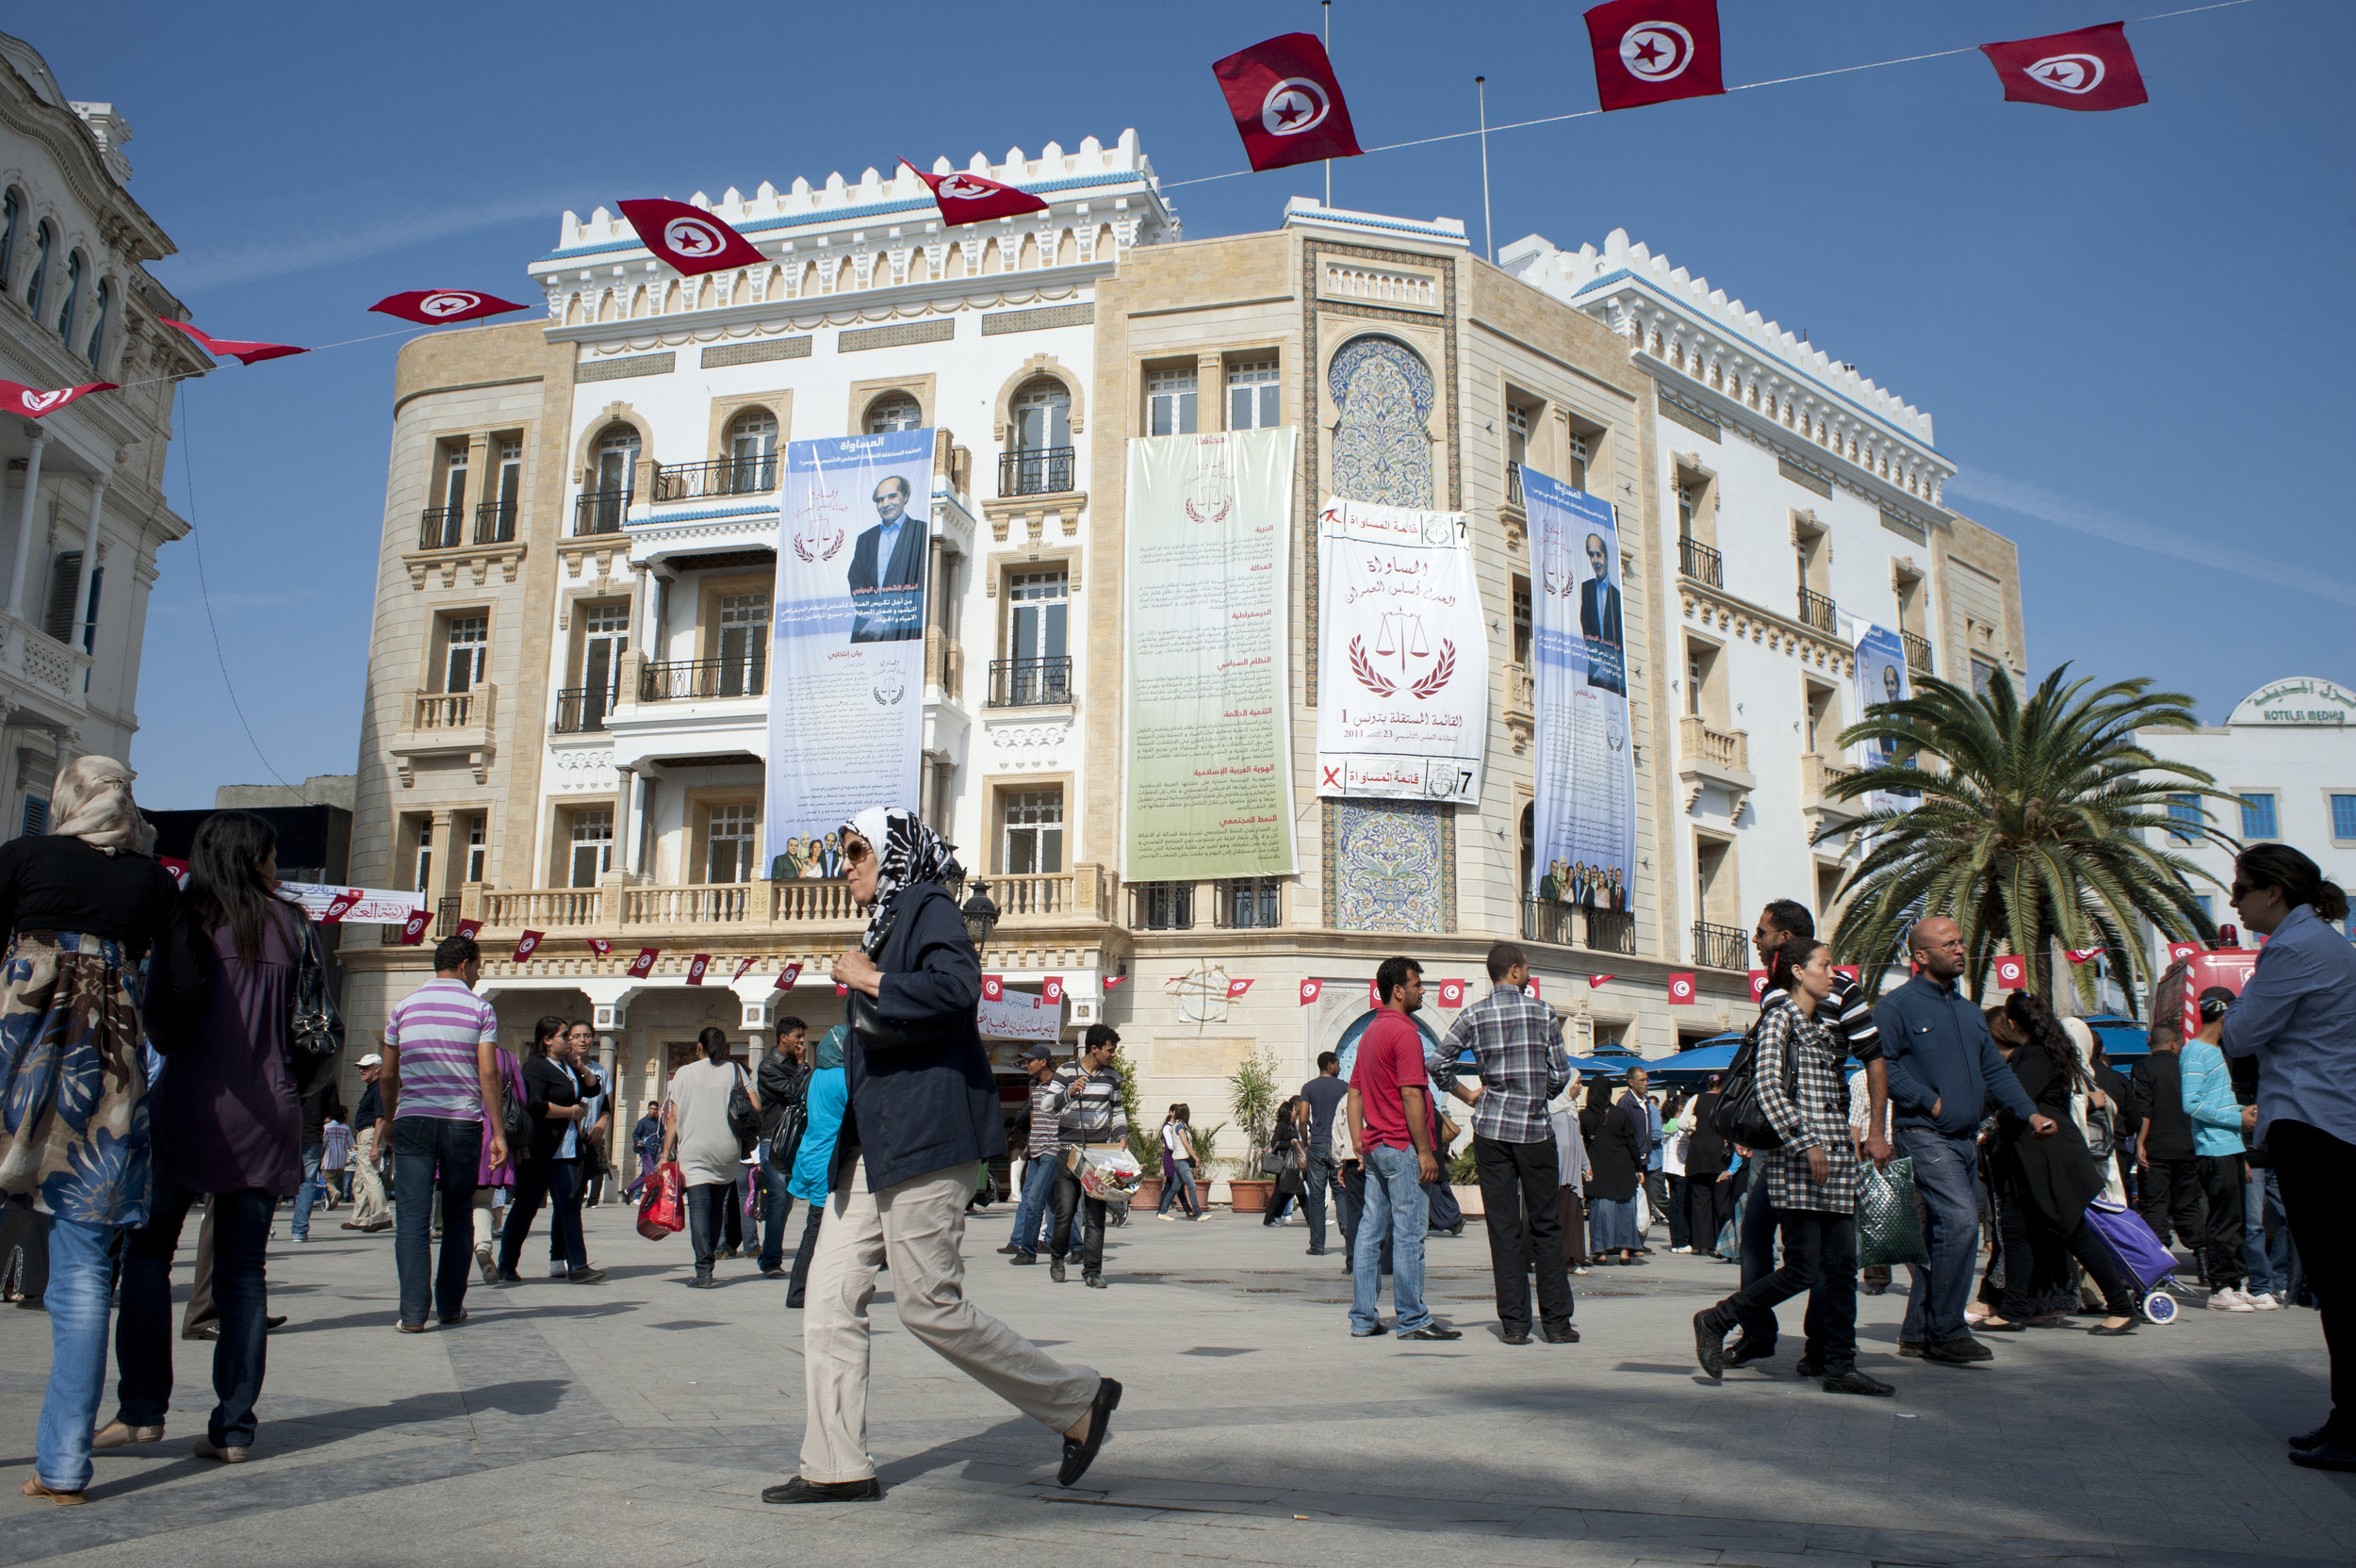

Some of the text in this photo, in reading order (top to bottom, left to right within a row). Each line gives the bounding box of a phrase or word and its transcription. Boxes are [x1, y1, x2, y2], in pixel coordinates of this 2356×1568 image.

[840, 436, 884, 452] المساواة
[1255, 525, 1273, 533] الحرية
[1350, 514, 1389, 530] المساواة
[1455, 521, 1466, 539] 7
[1250, 563, 1272, 571] العدالة
[1366, 554, 1427, 577] المساواة
[1345, 577, 1383, 606] العمران
[1388, 578, 1420, 596] أساس
[1231, 609, 1271, 619] الديمقراطية
[850, 648, 862, 658] بيان
[1217, 655, 1270, 670] النظام السياسي
[1223, 707, 1271, 717] التنمية الدائمة
[1341, 709, 1463, 727] القائمة المستقلة بتونس 1
[2264, 710, 2294, 721] HOTEL
[1343, 728, 1364, 739] 2011
[1383, 729, 1392, 738] 23
[1193, 763, 1274, 776] الهوية العربية الإسلامية
[1349, 768, 1418, 785] قائمة المساواة
[1460, 771, 1473, 793] 7
[1219, 814, 1277, 827] النمط المجتمعي
